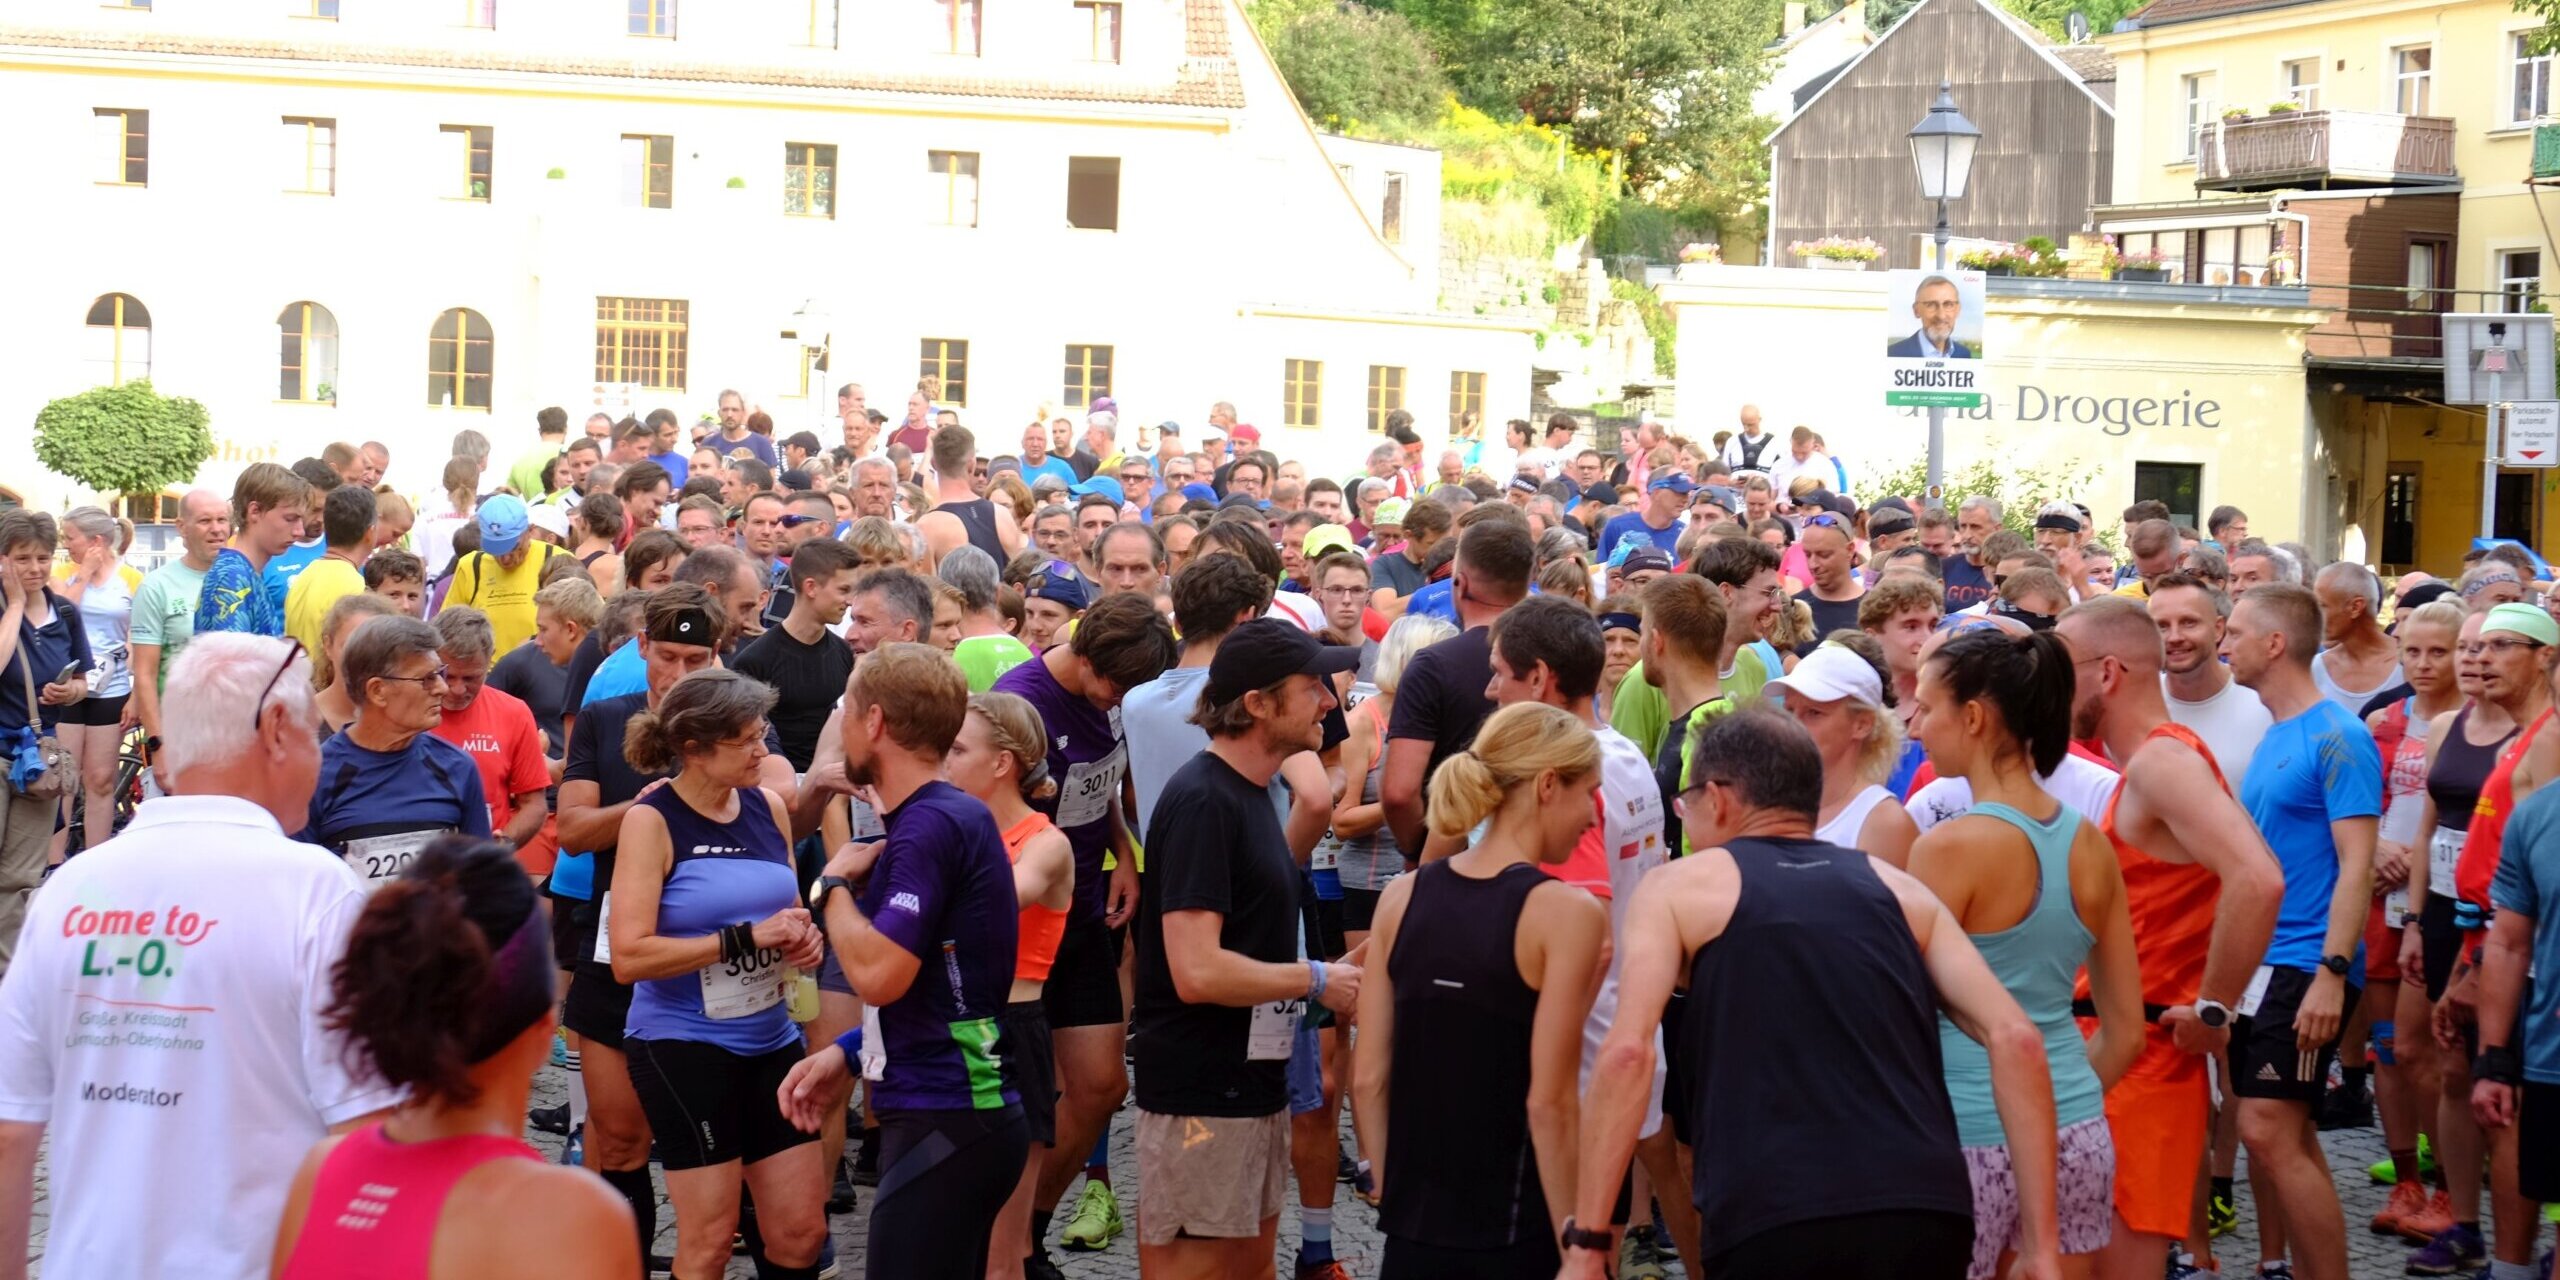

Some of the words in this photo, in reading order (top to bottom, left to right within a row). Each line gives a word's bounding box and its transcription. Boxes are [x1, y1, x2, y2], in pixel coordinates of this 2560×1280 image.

[1894, 369, 1974, 388] SCHUSTER
[462, 739, 501, 753] MILA
[1080, 765, 1116, 796] 3011
[63, 904, 156, 938] Come
[164, 904, 201, 937] to
[81, 939, 174, 978] L.-O.
